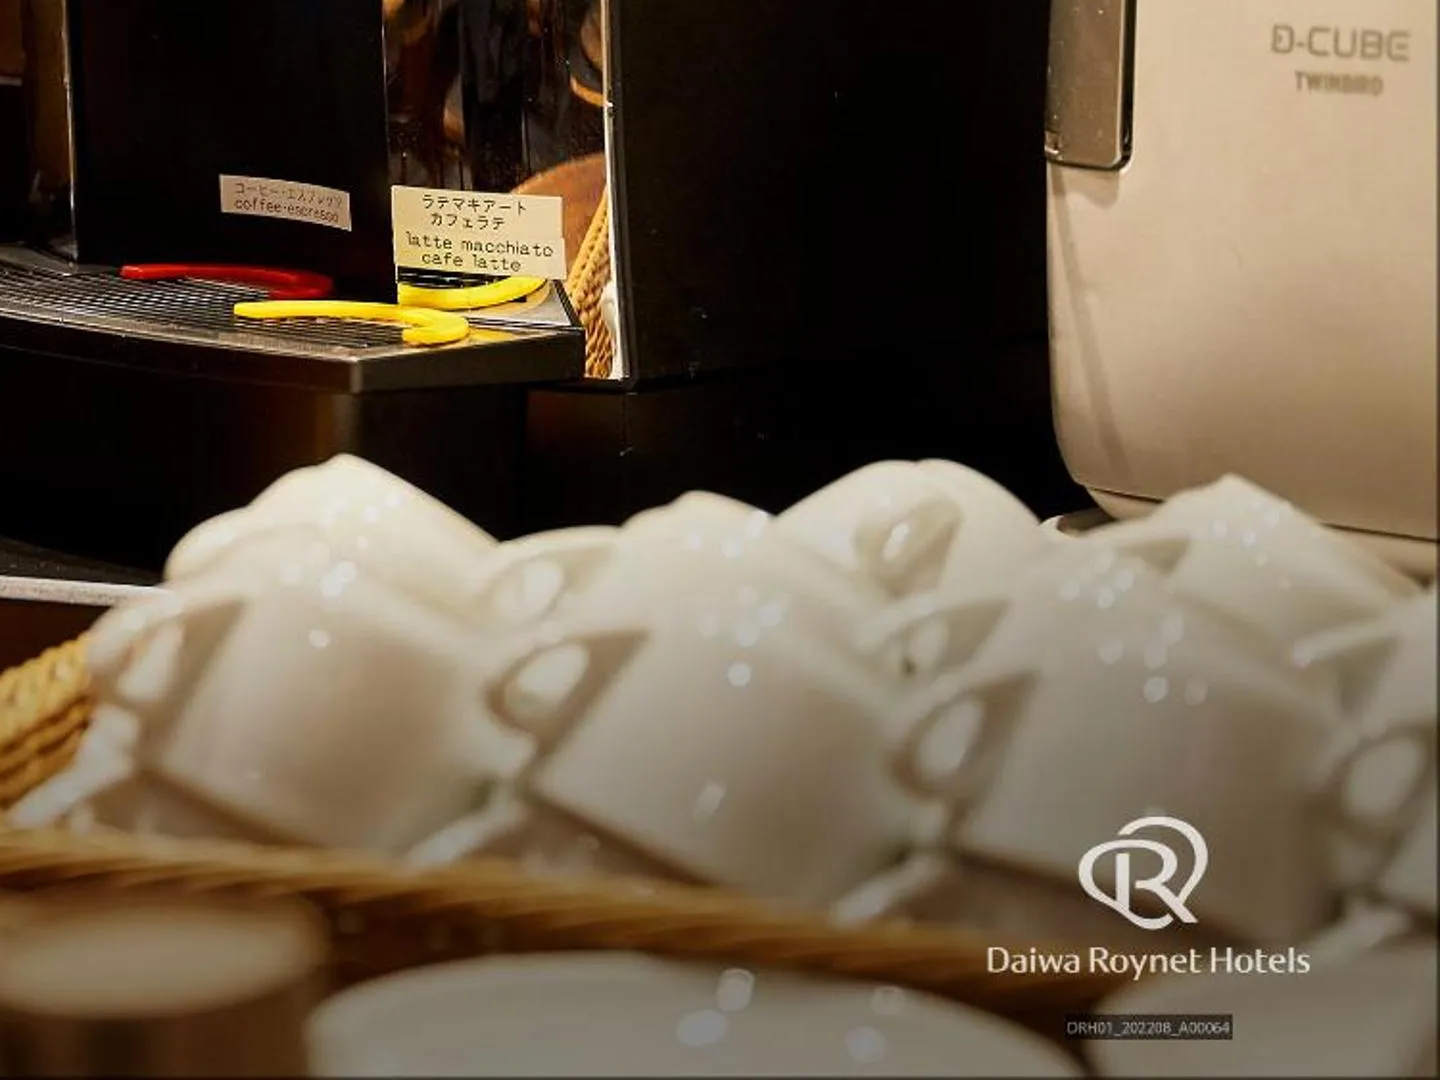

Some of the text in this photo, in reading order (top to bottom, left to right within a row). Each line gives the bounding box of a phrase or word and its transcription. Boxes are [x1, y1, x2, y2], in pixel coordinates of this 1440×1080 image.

[1270, 23, 1412, 62] D-CUBE
[422, 193, 527, 217] ラテマキアート
[431, 213, 506, 231] カフェラテ
[406, 231, 554, 258] latte macchiato
[421, 252, 522, 273] cafe latte
